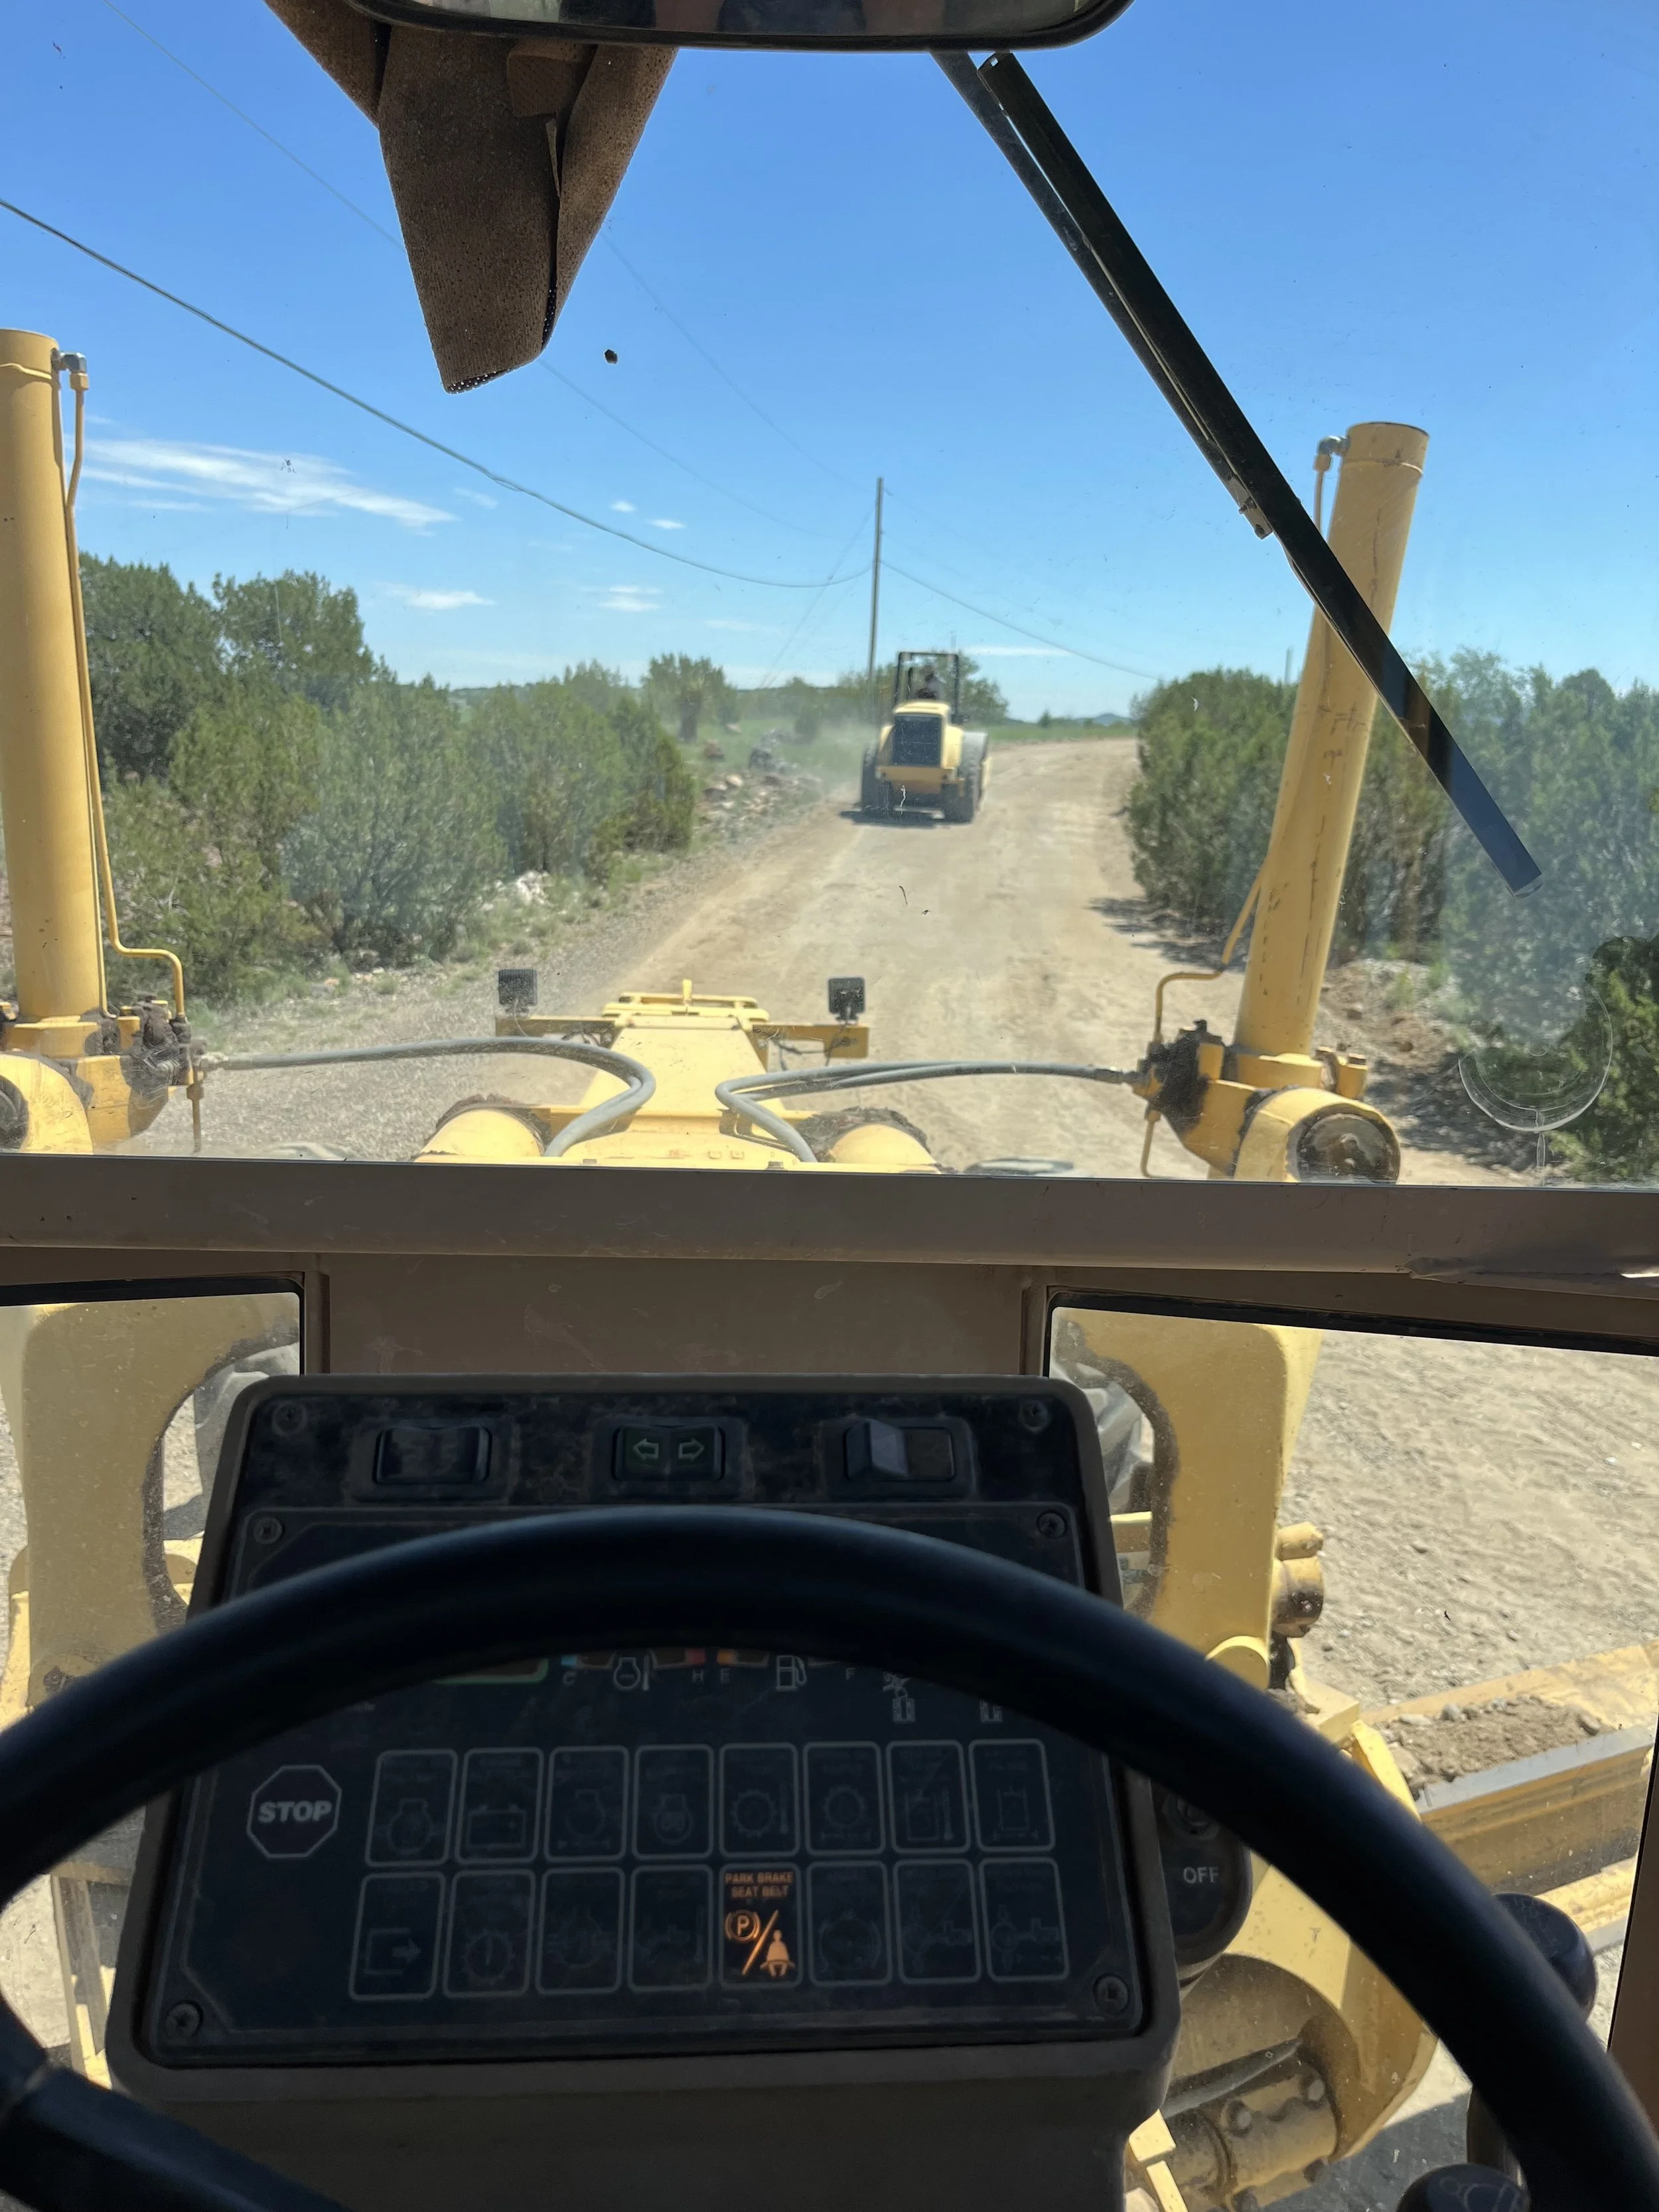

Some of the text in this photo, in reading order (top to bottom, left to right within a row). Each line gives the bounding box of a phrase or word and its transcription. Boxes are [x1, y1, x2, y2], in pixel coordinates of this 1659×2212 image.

[257, 1800, 332, 1824] STOP
[725, 1872, 794, 1884] PARK BRAKE
[1183, 1866, 1219, 1884] OFF
[731, 1885, 788, 1898] SEAT BELT
